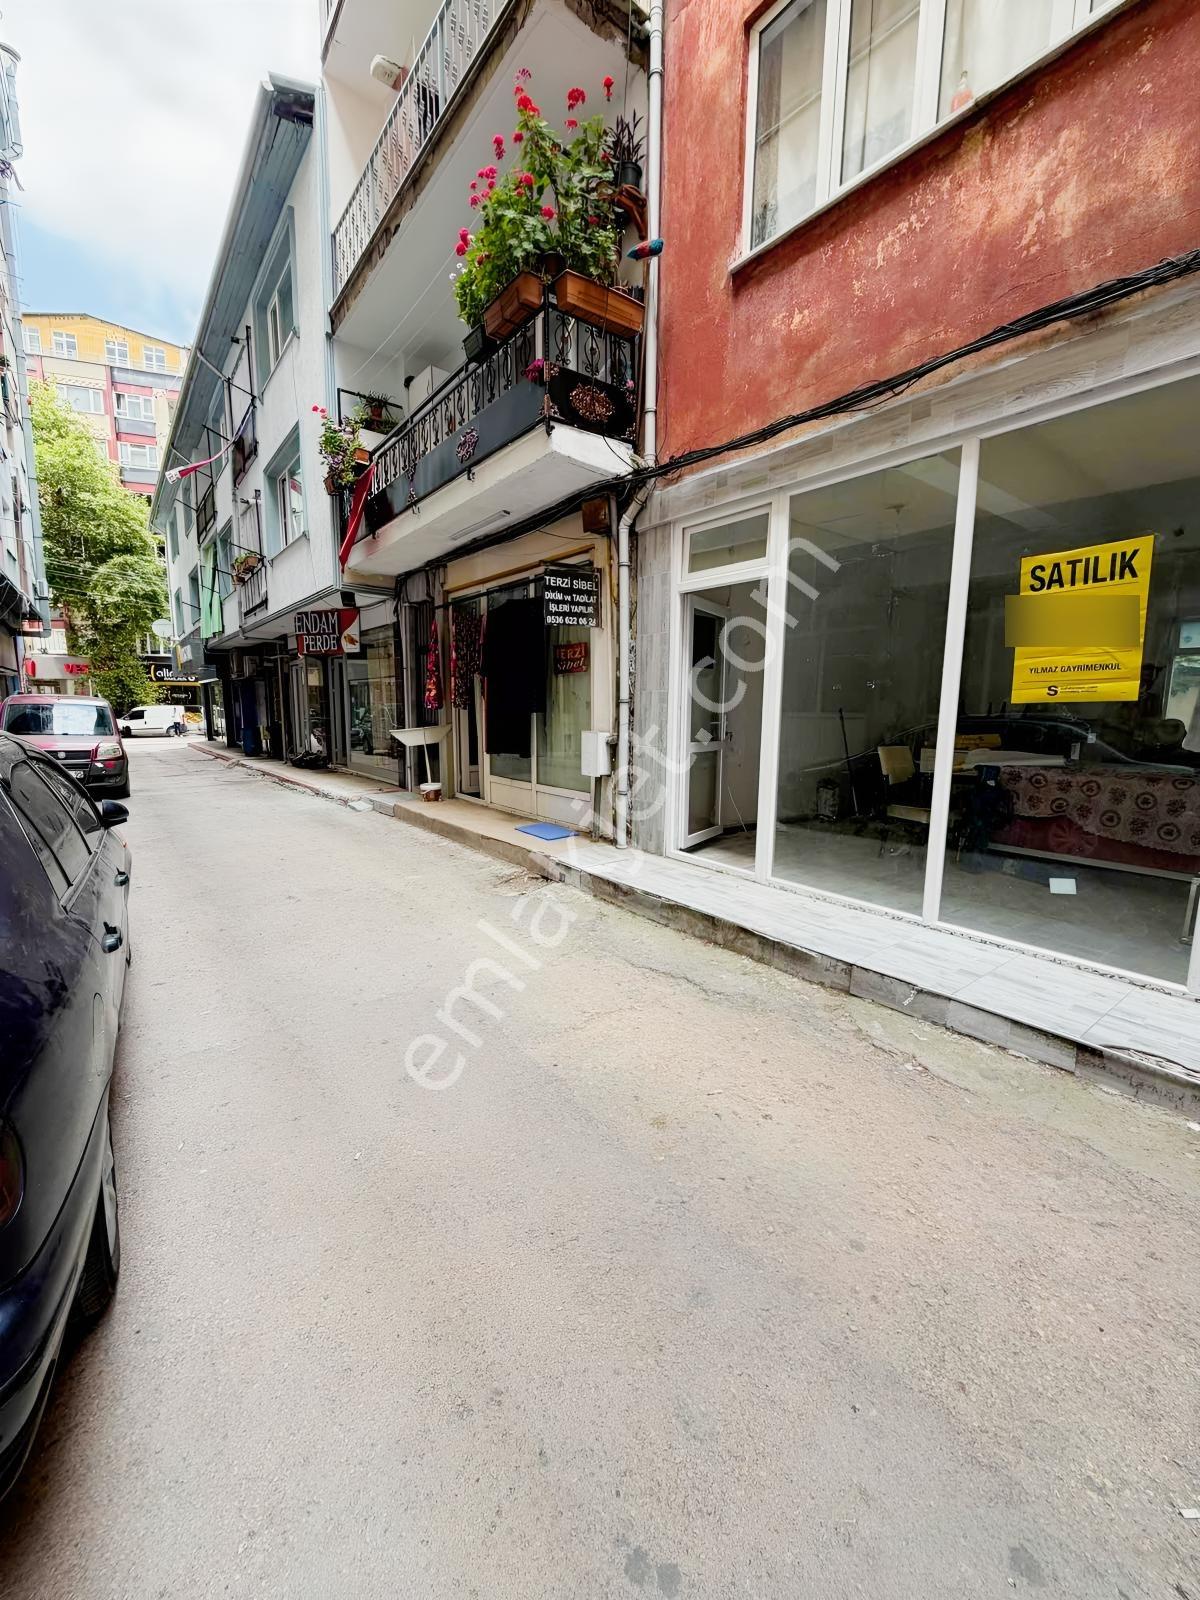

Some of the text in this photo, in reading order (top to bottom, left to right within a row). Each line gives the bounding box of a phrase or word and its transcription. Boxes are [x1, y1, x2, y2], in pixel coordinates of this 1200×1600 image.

[1029, 548, 1140, 592] SATILIK
[544, 576, 598, 591] TERZİ SİBEL
[295, 611, 339, 636] ENDAM
[303, 634, 338, 654] PERDE
[1029, 663, 1121, 674] YILMAZ GAYRİMENKUL
